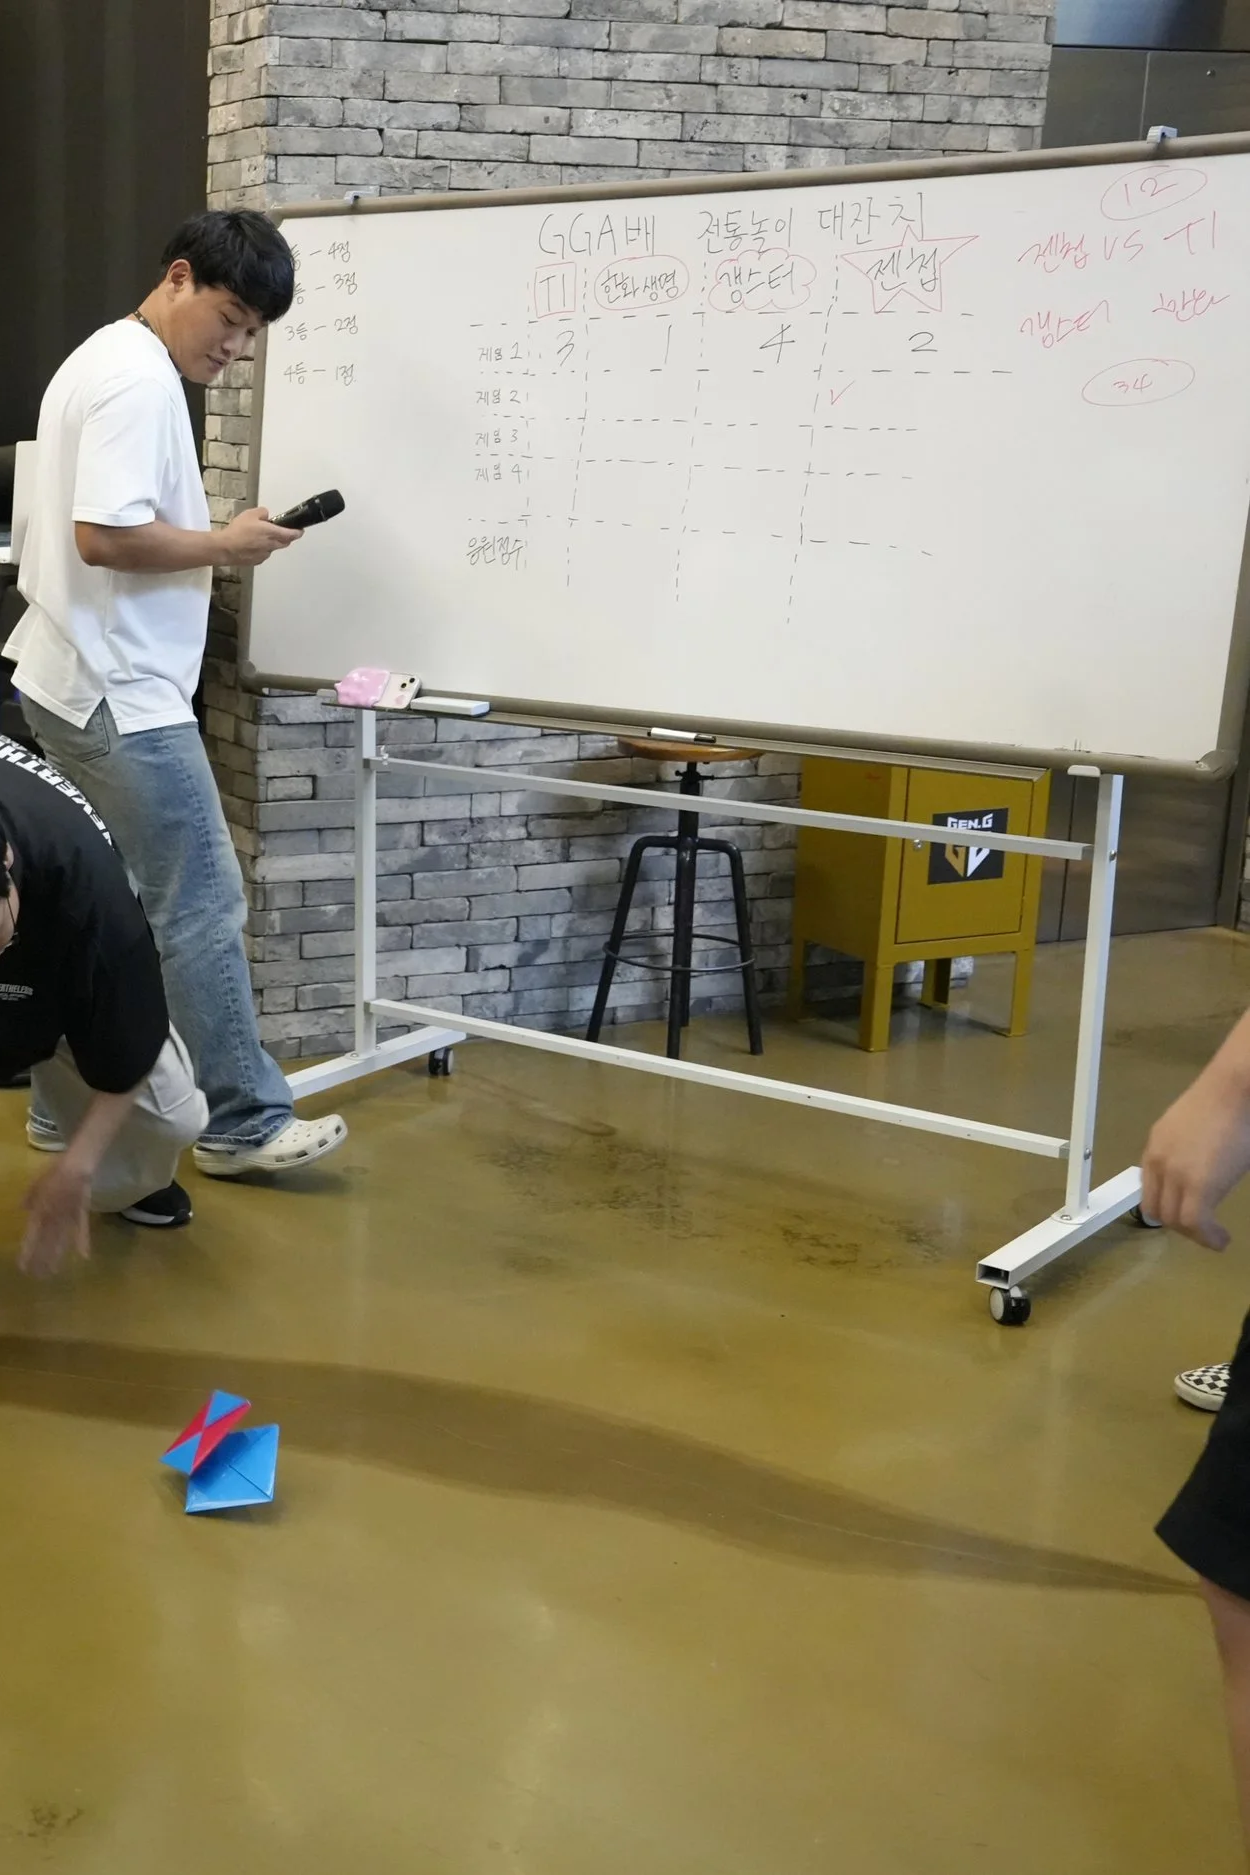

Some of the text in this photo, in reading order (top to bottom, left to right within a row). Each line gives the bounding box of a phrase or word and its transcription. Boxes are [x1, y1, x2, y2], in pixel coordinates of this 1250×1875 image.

[538, 191, 925, 261] GGA배 전통놀이 대잔치
[333, 271, 358, 296] 3점
[758, 323, 796, 364] 4
[908, 332, 939, 353] 2
